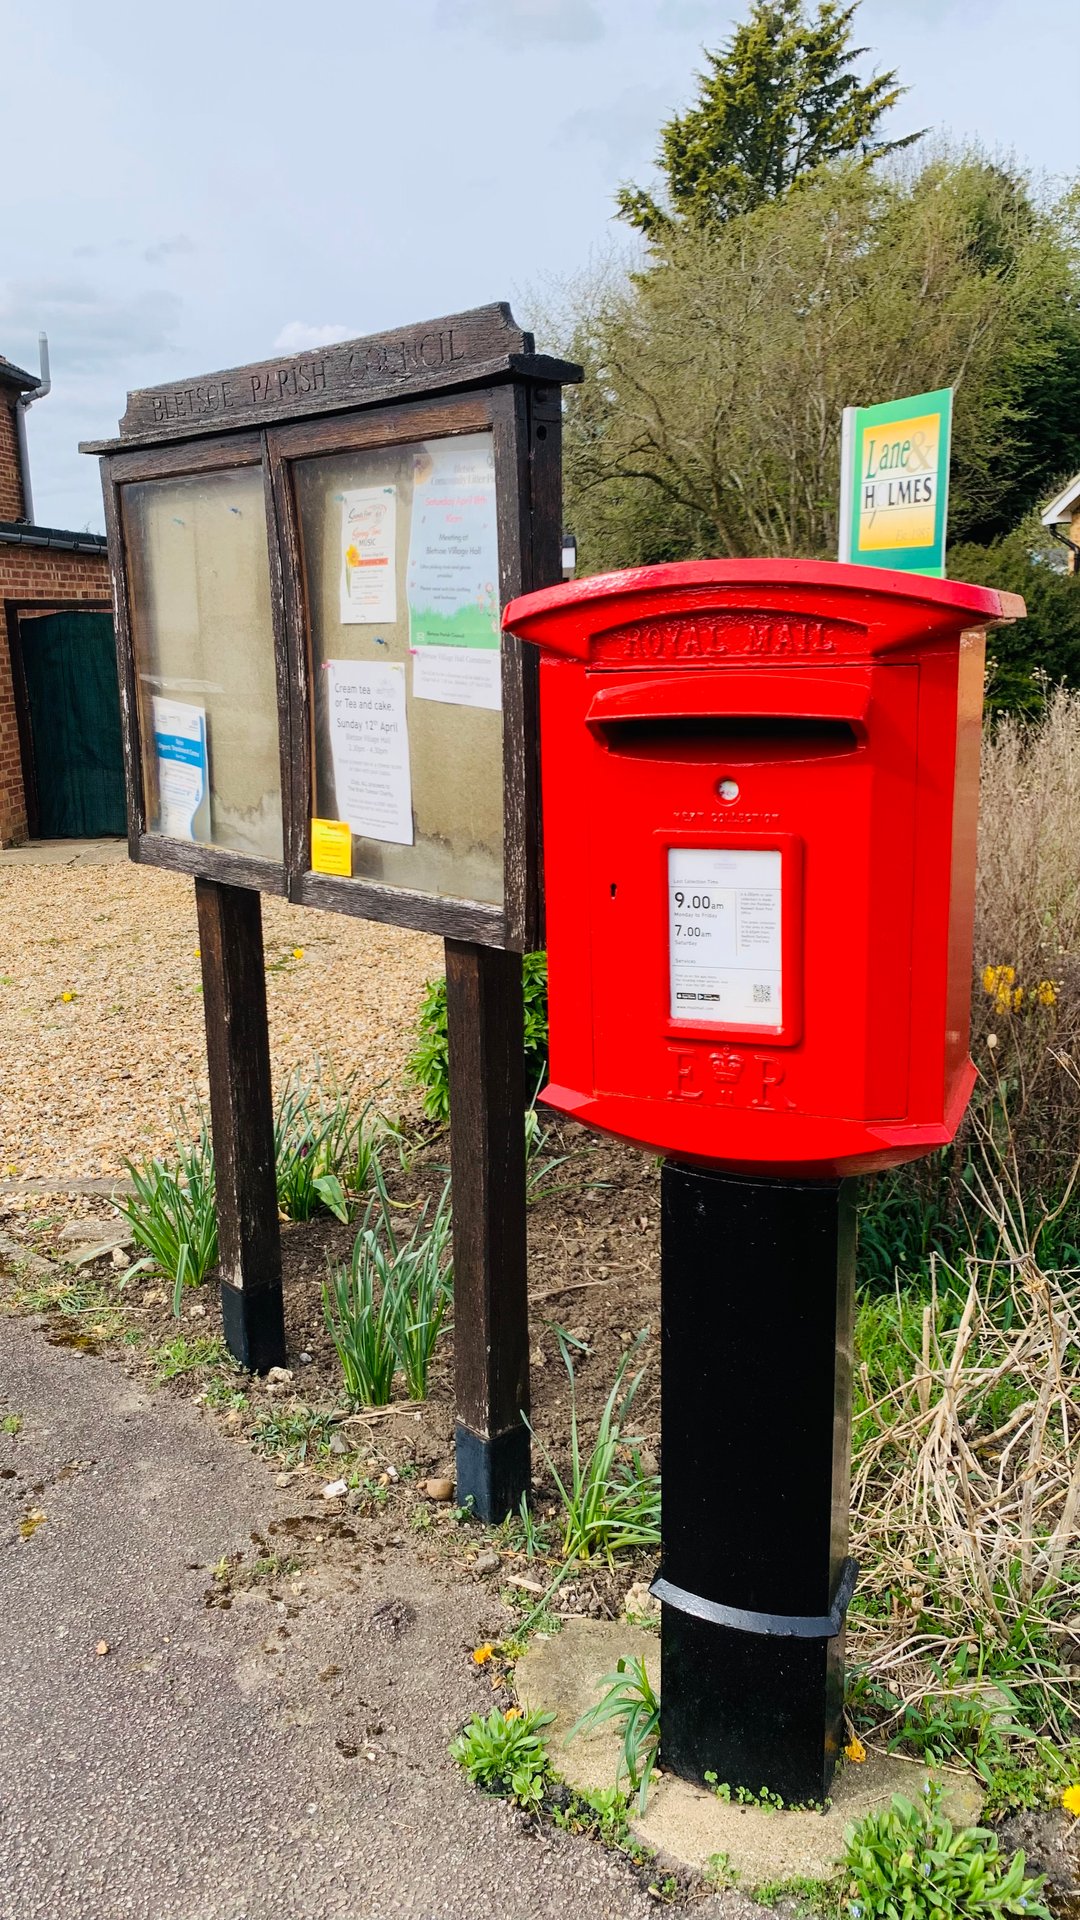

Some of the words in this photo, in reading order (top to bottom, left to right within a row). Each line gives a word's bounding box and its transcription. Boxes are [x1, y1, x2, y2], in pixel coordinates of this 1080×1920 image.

[152, 381, 234, 422] BLETSOE
[250, 362, 327, 403] PARISH
[348, 330, 464, 380] COUNCIL
[865, 439, 911, 479] Lane
[448, 546, 468, 557] Village
[469, 547, 482, 555] Hall
[624, 625, 730, 657] ROYAL
[746, 622, 837, 655] MAIL
[335, 683, 358, 694] Cream
[359, 685, 371, 695] tea
[335, 699, 342, 708] or
[344, 698, 357, 709] Tea
[359, 700, 372, 710] and
[374, 701, 394, 711] cake.
[336, 717, 363, 731] Sunday
[380, 722, 398, 734] April
[674, 891, 724, 910] 9.00am
[674, 924, 712, 938] 7.00am
[666, 1046, 705, 1102] E
[751, 1054, 798, 1111] R
